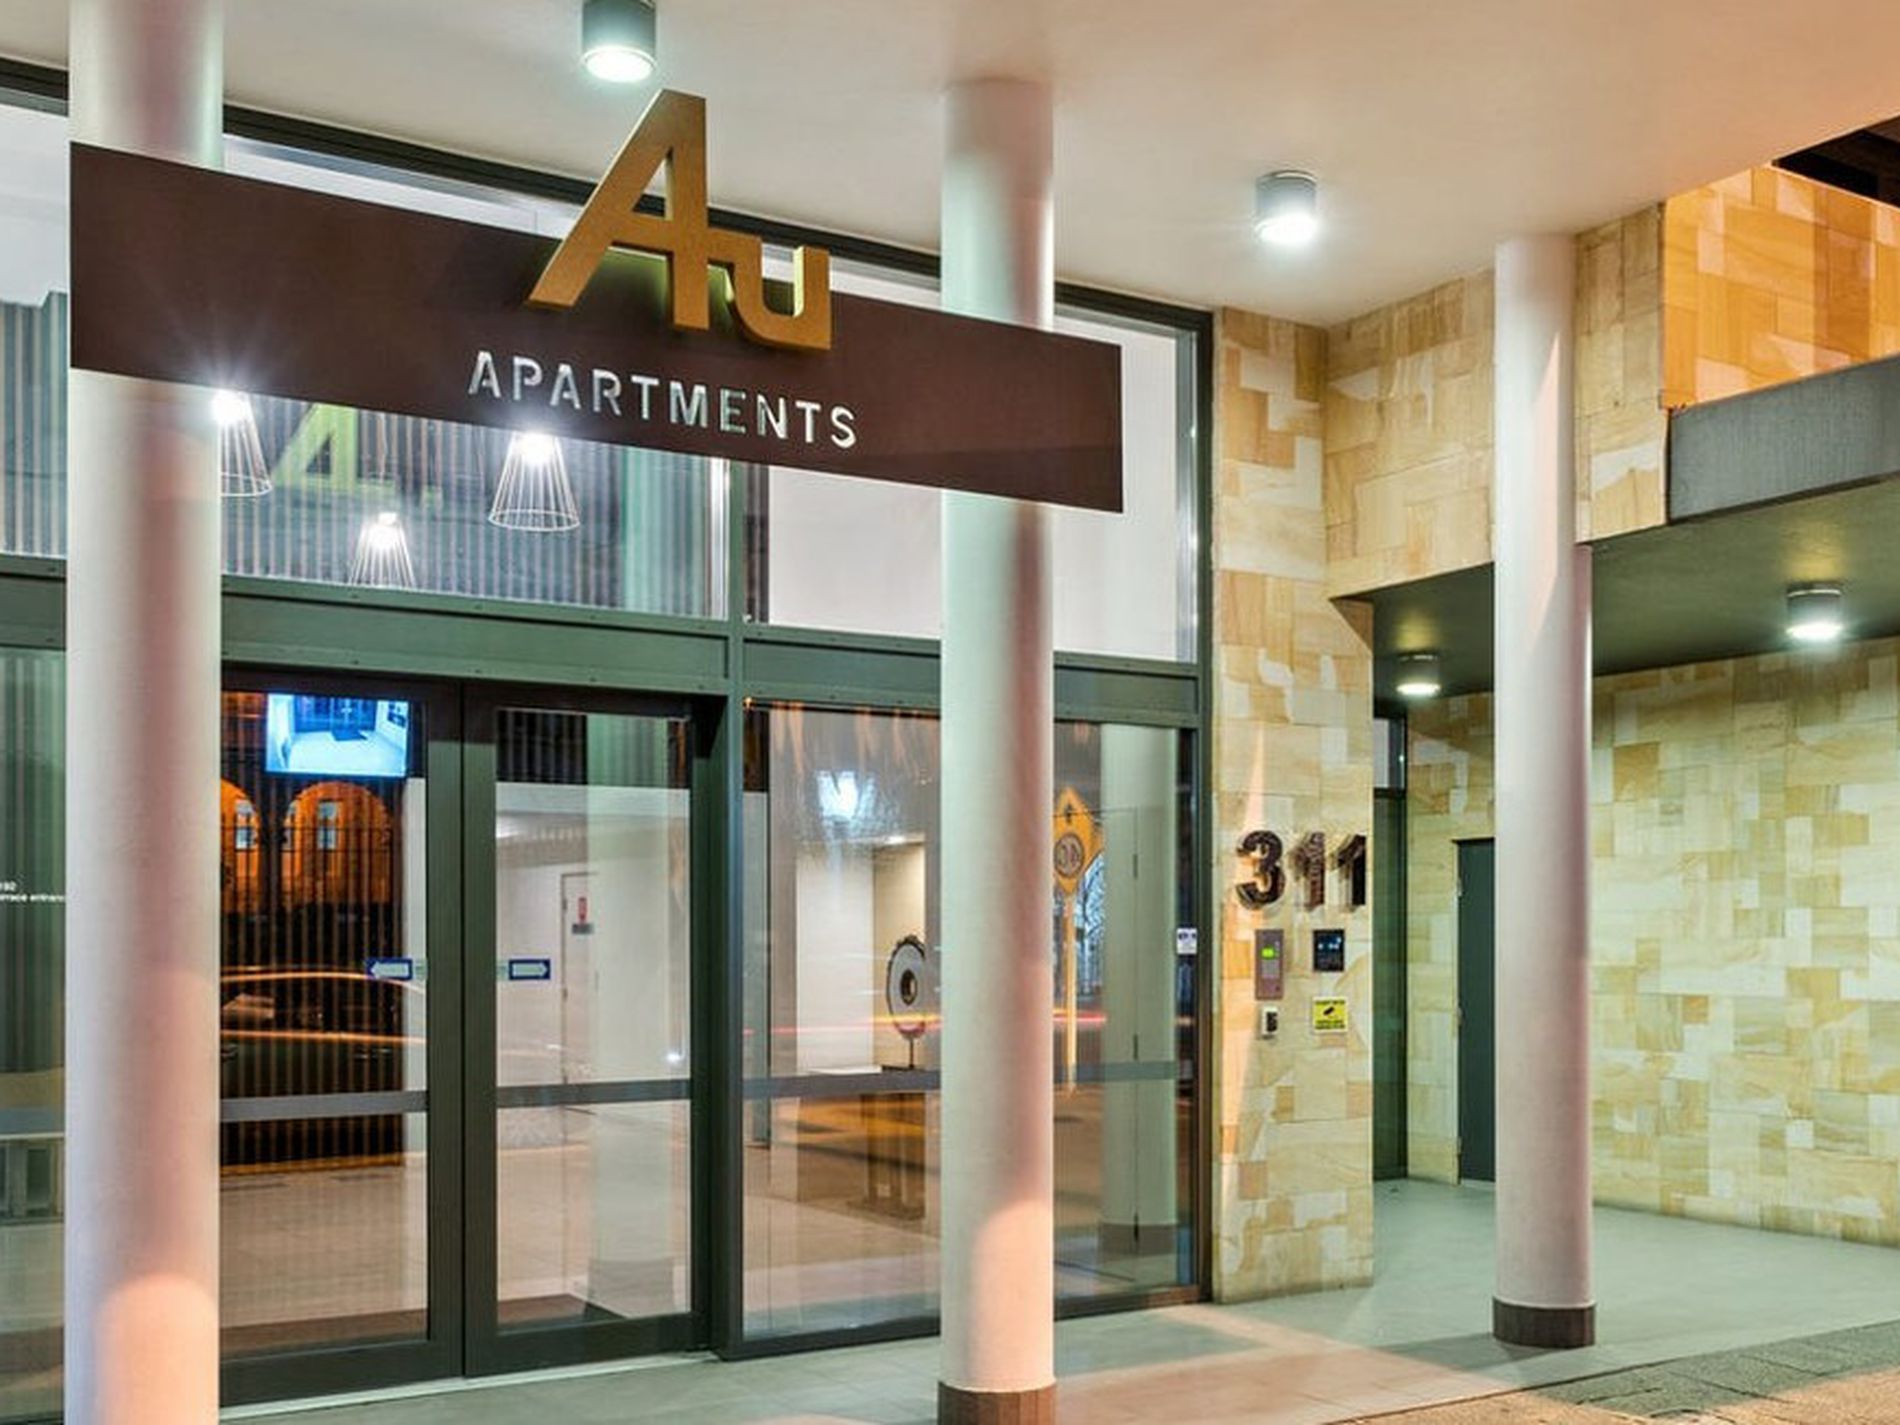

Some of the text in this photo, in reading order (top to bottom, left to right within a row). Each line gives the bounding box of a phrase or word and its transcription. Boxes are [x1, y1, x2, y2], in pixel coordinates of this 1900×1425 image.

[527, 88, 832, 350] Au
[467, 349, 858, 450] APARTMENTS
[1236, 830, 1367, 911] 311
